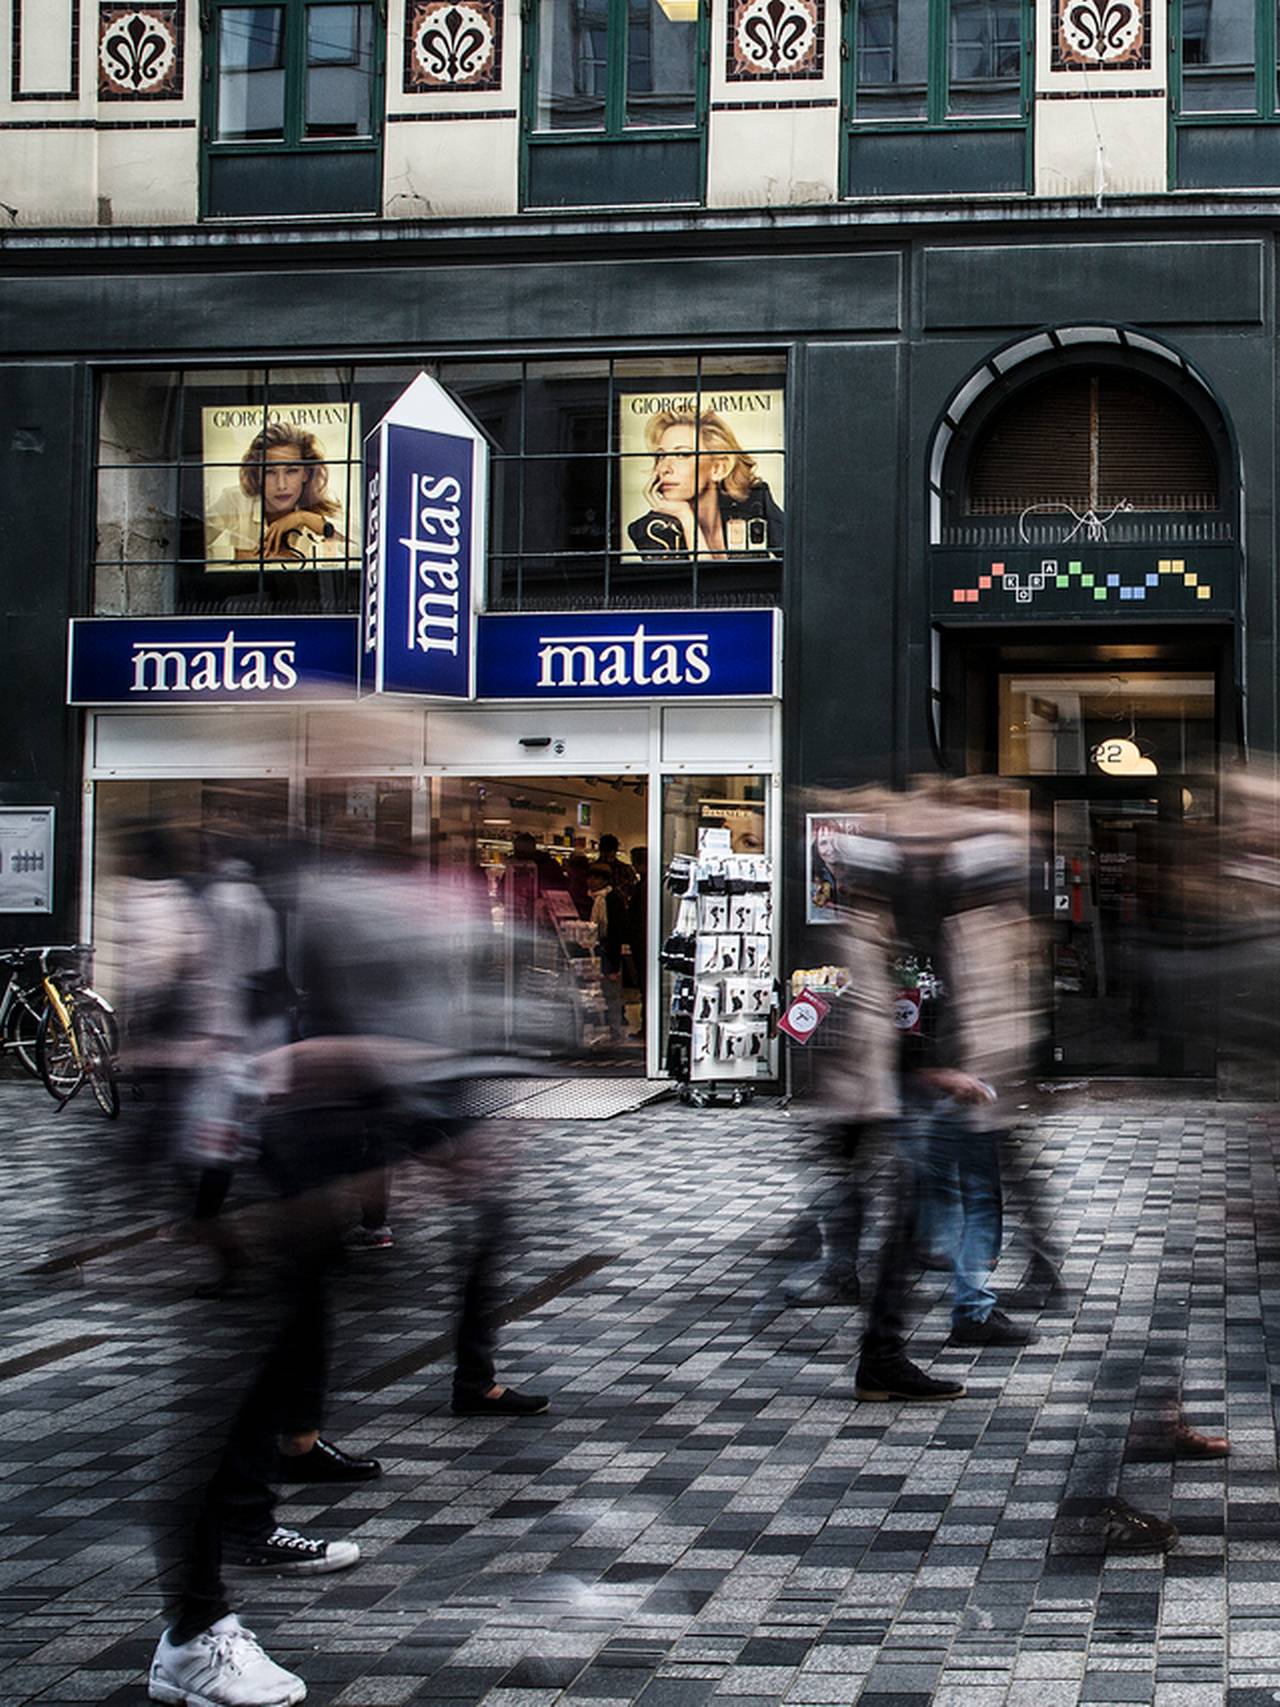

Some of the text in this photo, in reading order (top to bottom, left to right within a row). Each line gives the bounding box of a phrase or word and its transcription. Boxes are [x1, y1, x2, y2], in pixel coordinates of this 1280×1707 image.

[213, 408, 348, 428] GIORGO ARMANI
[710, 395, 772, 412] ARMANI
[399, 472, 462, 656] matas
[129, 630, 298, 691] matas
[537, 624, 711, 686] matas
[1090, 745, 1122, 763] 22
